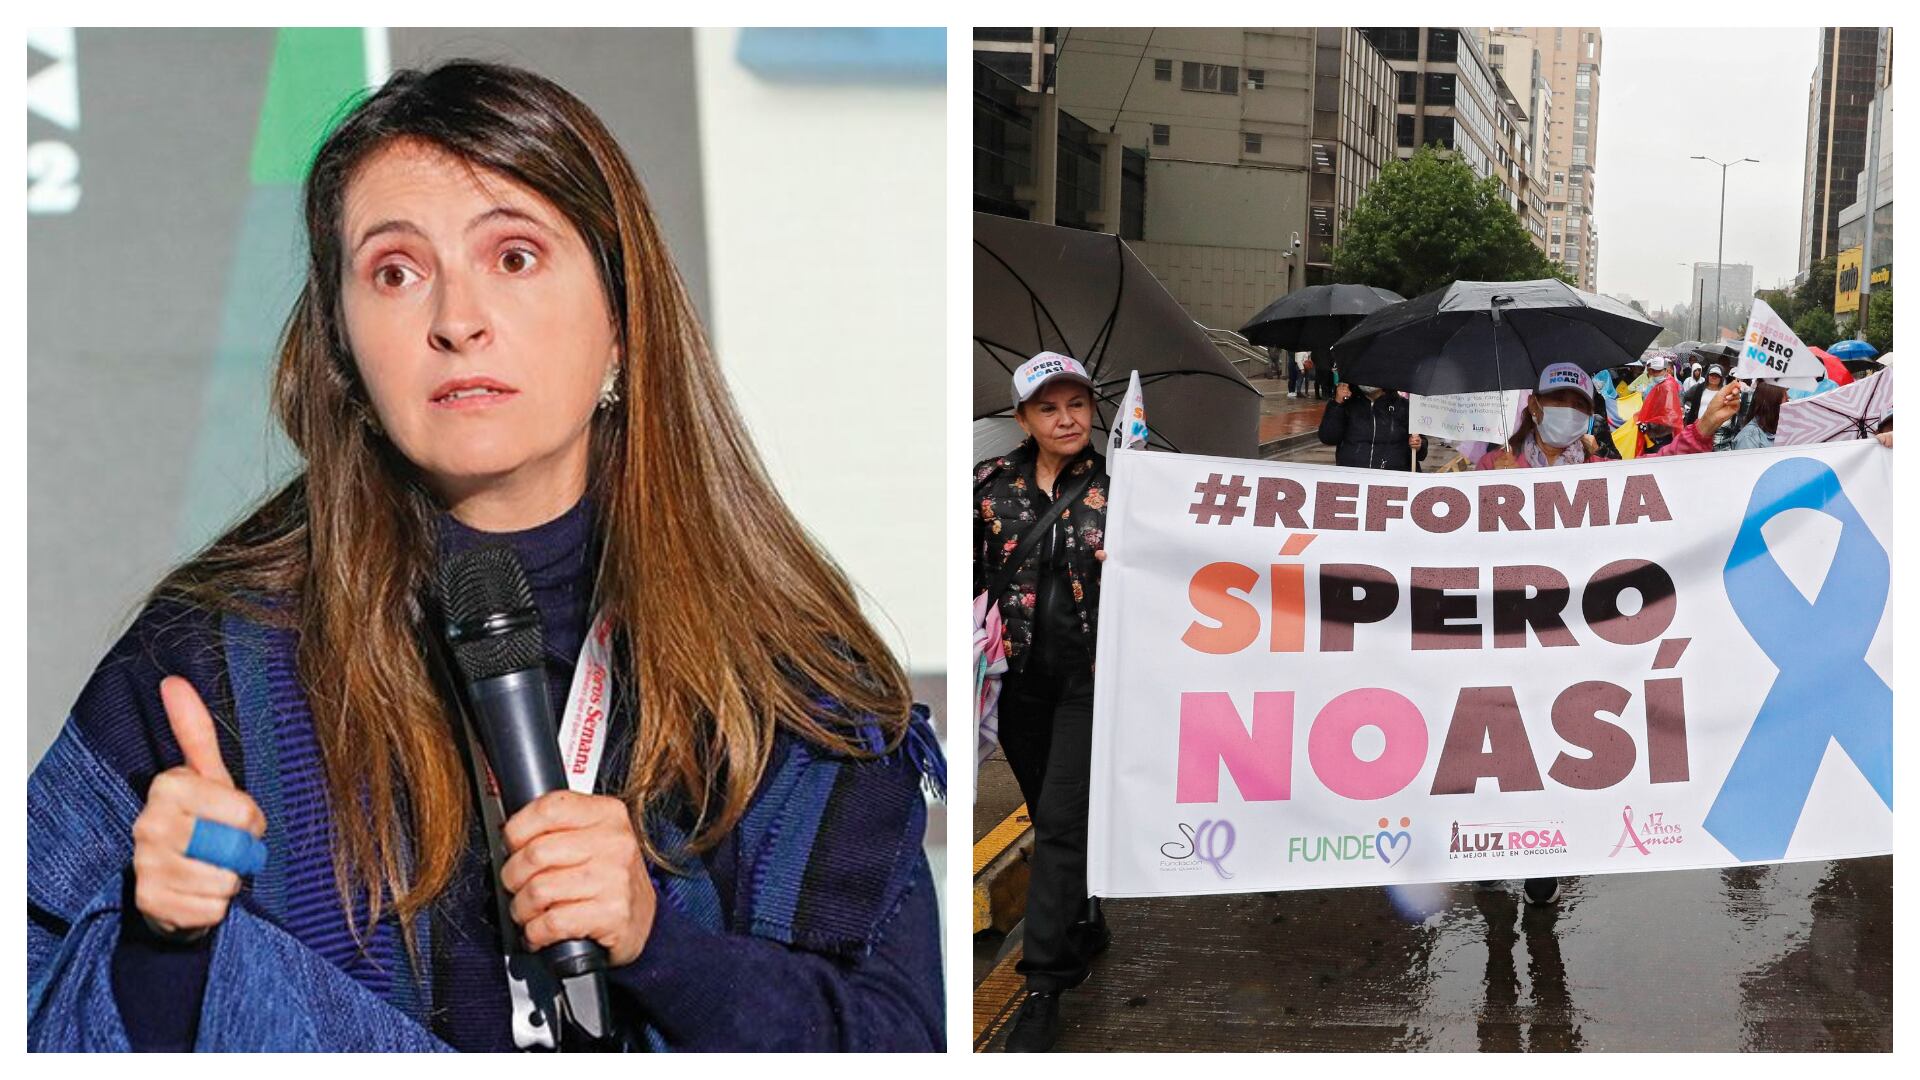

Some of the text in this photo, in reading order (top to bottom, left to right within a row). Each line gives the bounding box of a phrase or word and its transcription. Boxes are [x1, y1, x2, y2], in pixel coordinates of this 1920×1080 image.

[1188, 473, 1673, 534] #REFORMA
[1180, 533, 1677, 655] SÍPERO
[573, 706, 604, 774] Semana
[1176, 637, 1692, 804] NOASÍ
[1508, 829, 1568, 850] ROSA
[1641, 822, 1682, 835] Años
[1648, 812, 1664, 827] 17
[1523, 847, 1568, 856] ONCOLOGÍA
